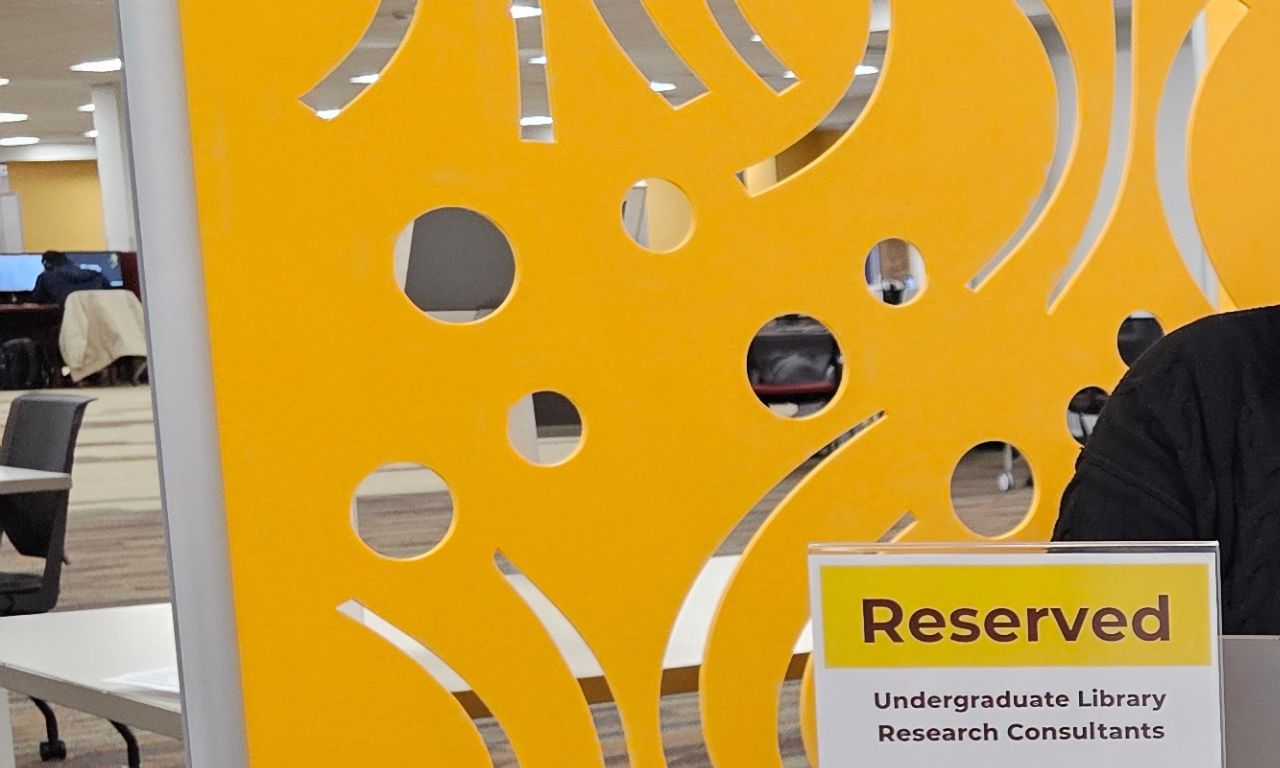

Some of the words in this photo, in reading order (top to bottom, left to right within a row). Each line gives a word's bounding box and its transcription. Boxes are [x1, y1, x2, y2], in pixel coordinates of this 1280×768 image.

[862, 594, 1170, 643] Reserved
[874, 690, 1070, 713] Undergraduate
[1078, 688, 1167, 711] Library
[878, 722, 999, 742] Research
[1007, 721, 1165, 742] Consultants
